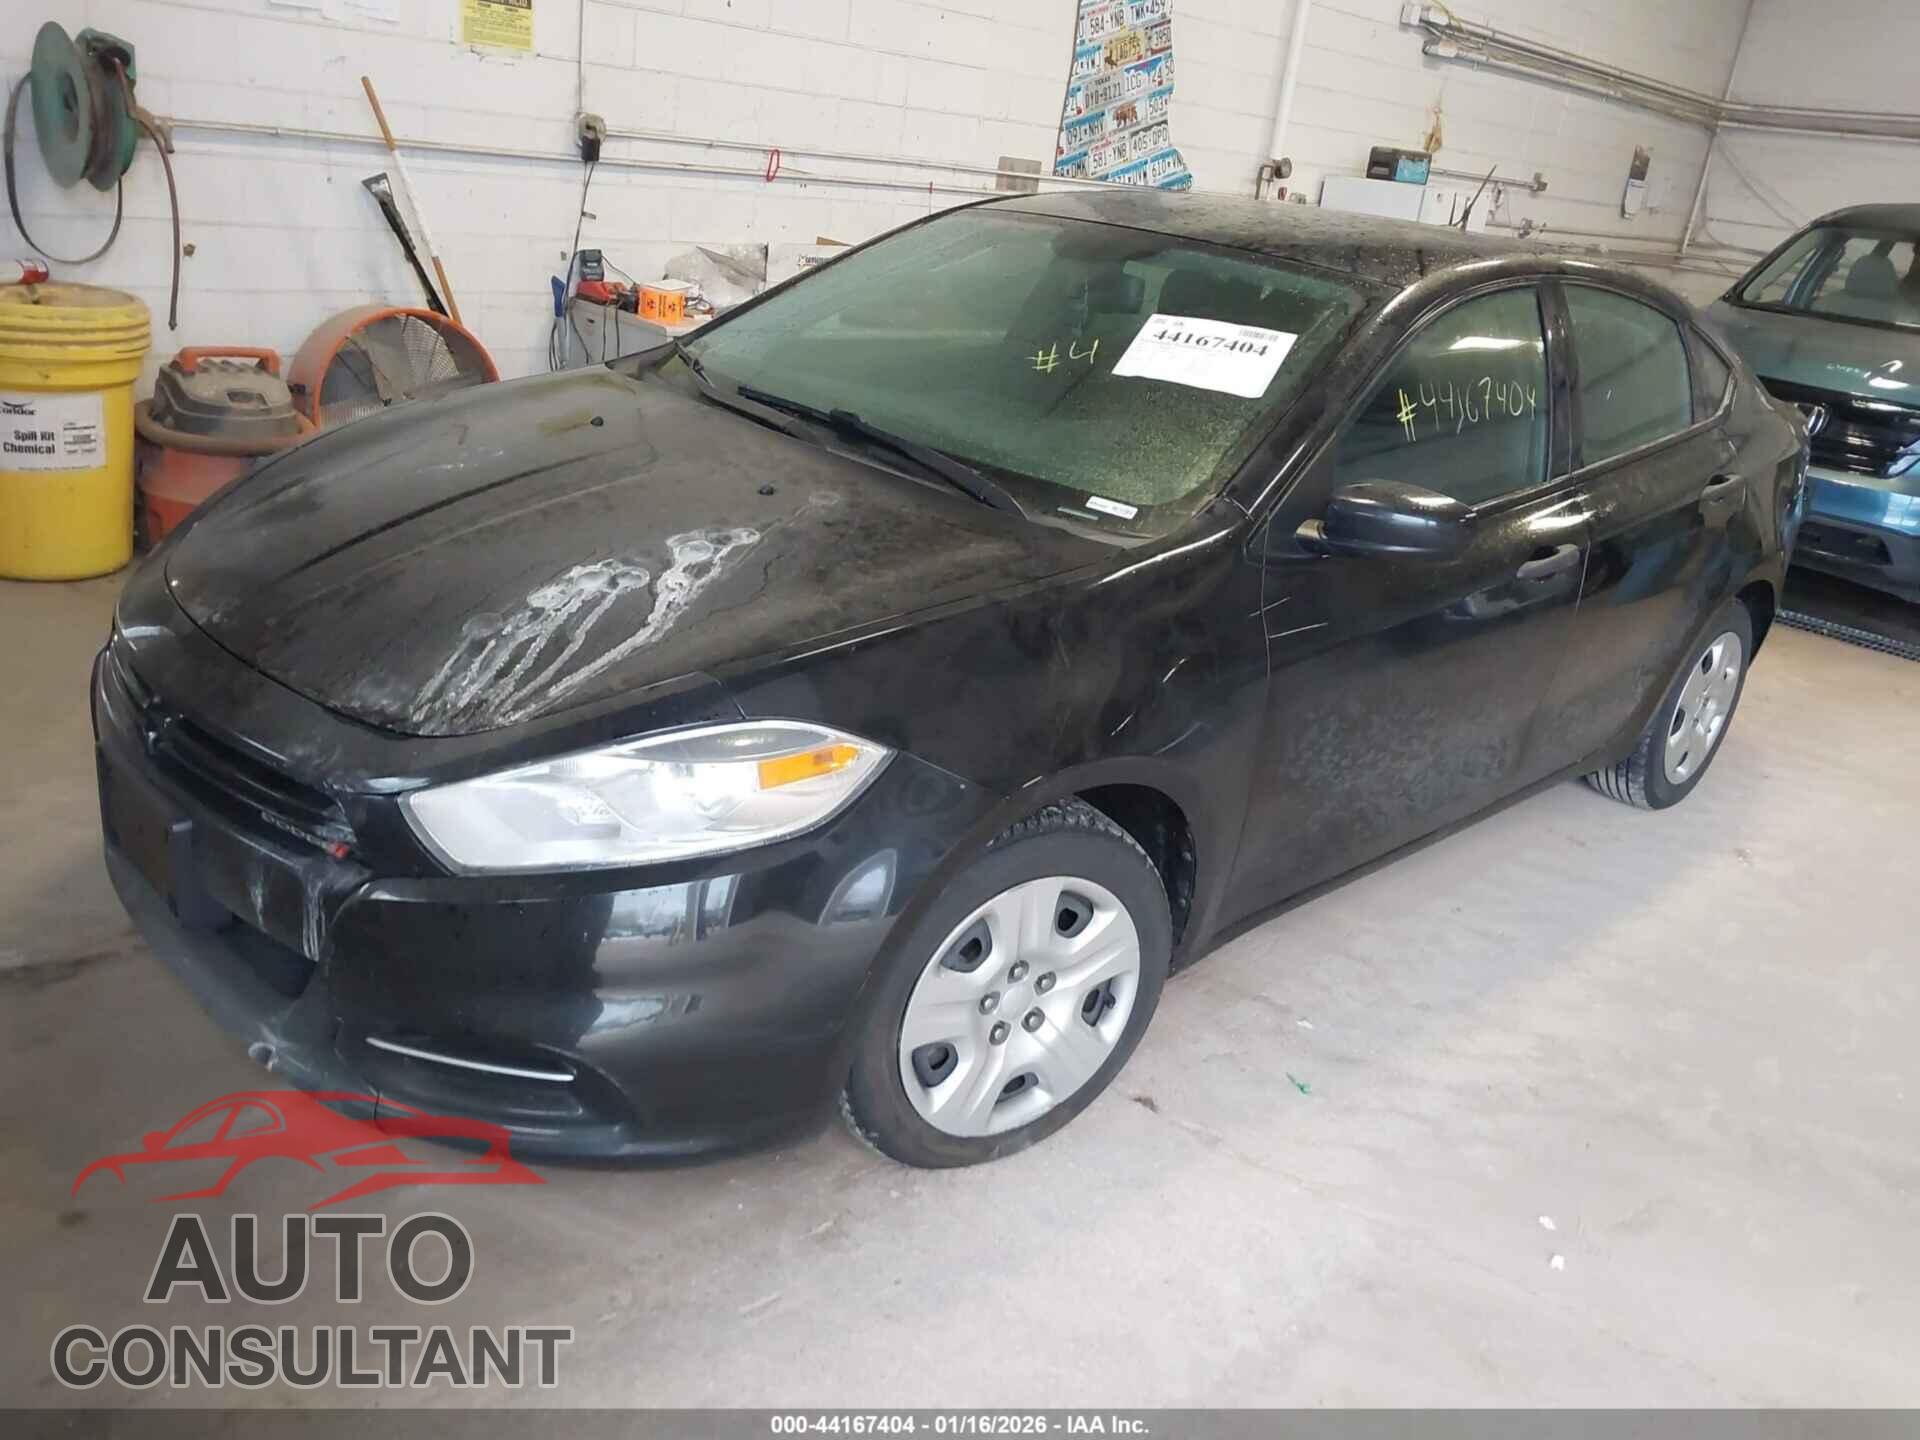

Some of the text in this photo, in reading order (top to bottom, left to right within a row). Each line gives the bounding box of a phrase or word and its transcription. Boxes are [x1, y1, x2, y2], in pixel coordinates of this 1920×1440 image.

[1153, 329, 1268, 357] 44167404
[0, 407, 36, 416] ondor
[14, 430, 55, 442] Spill Kit
[3, 442, 55, 455] Chemical
